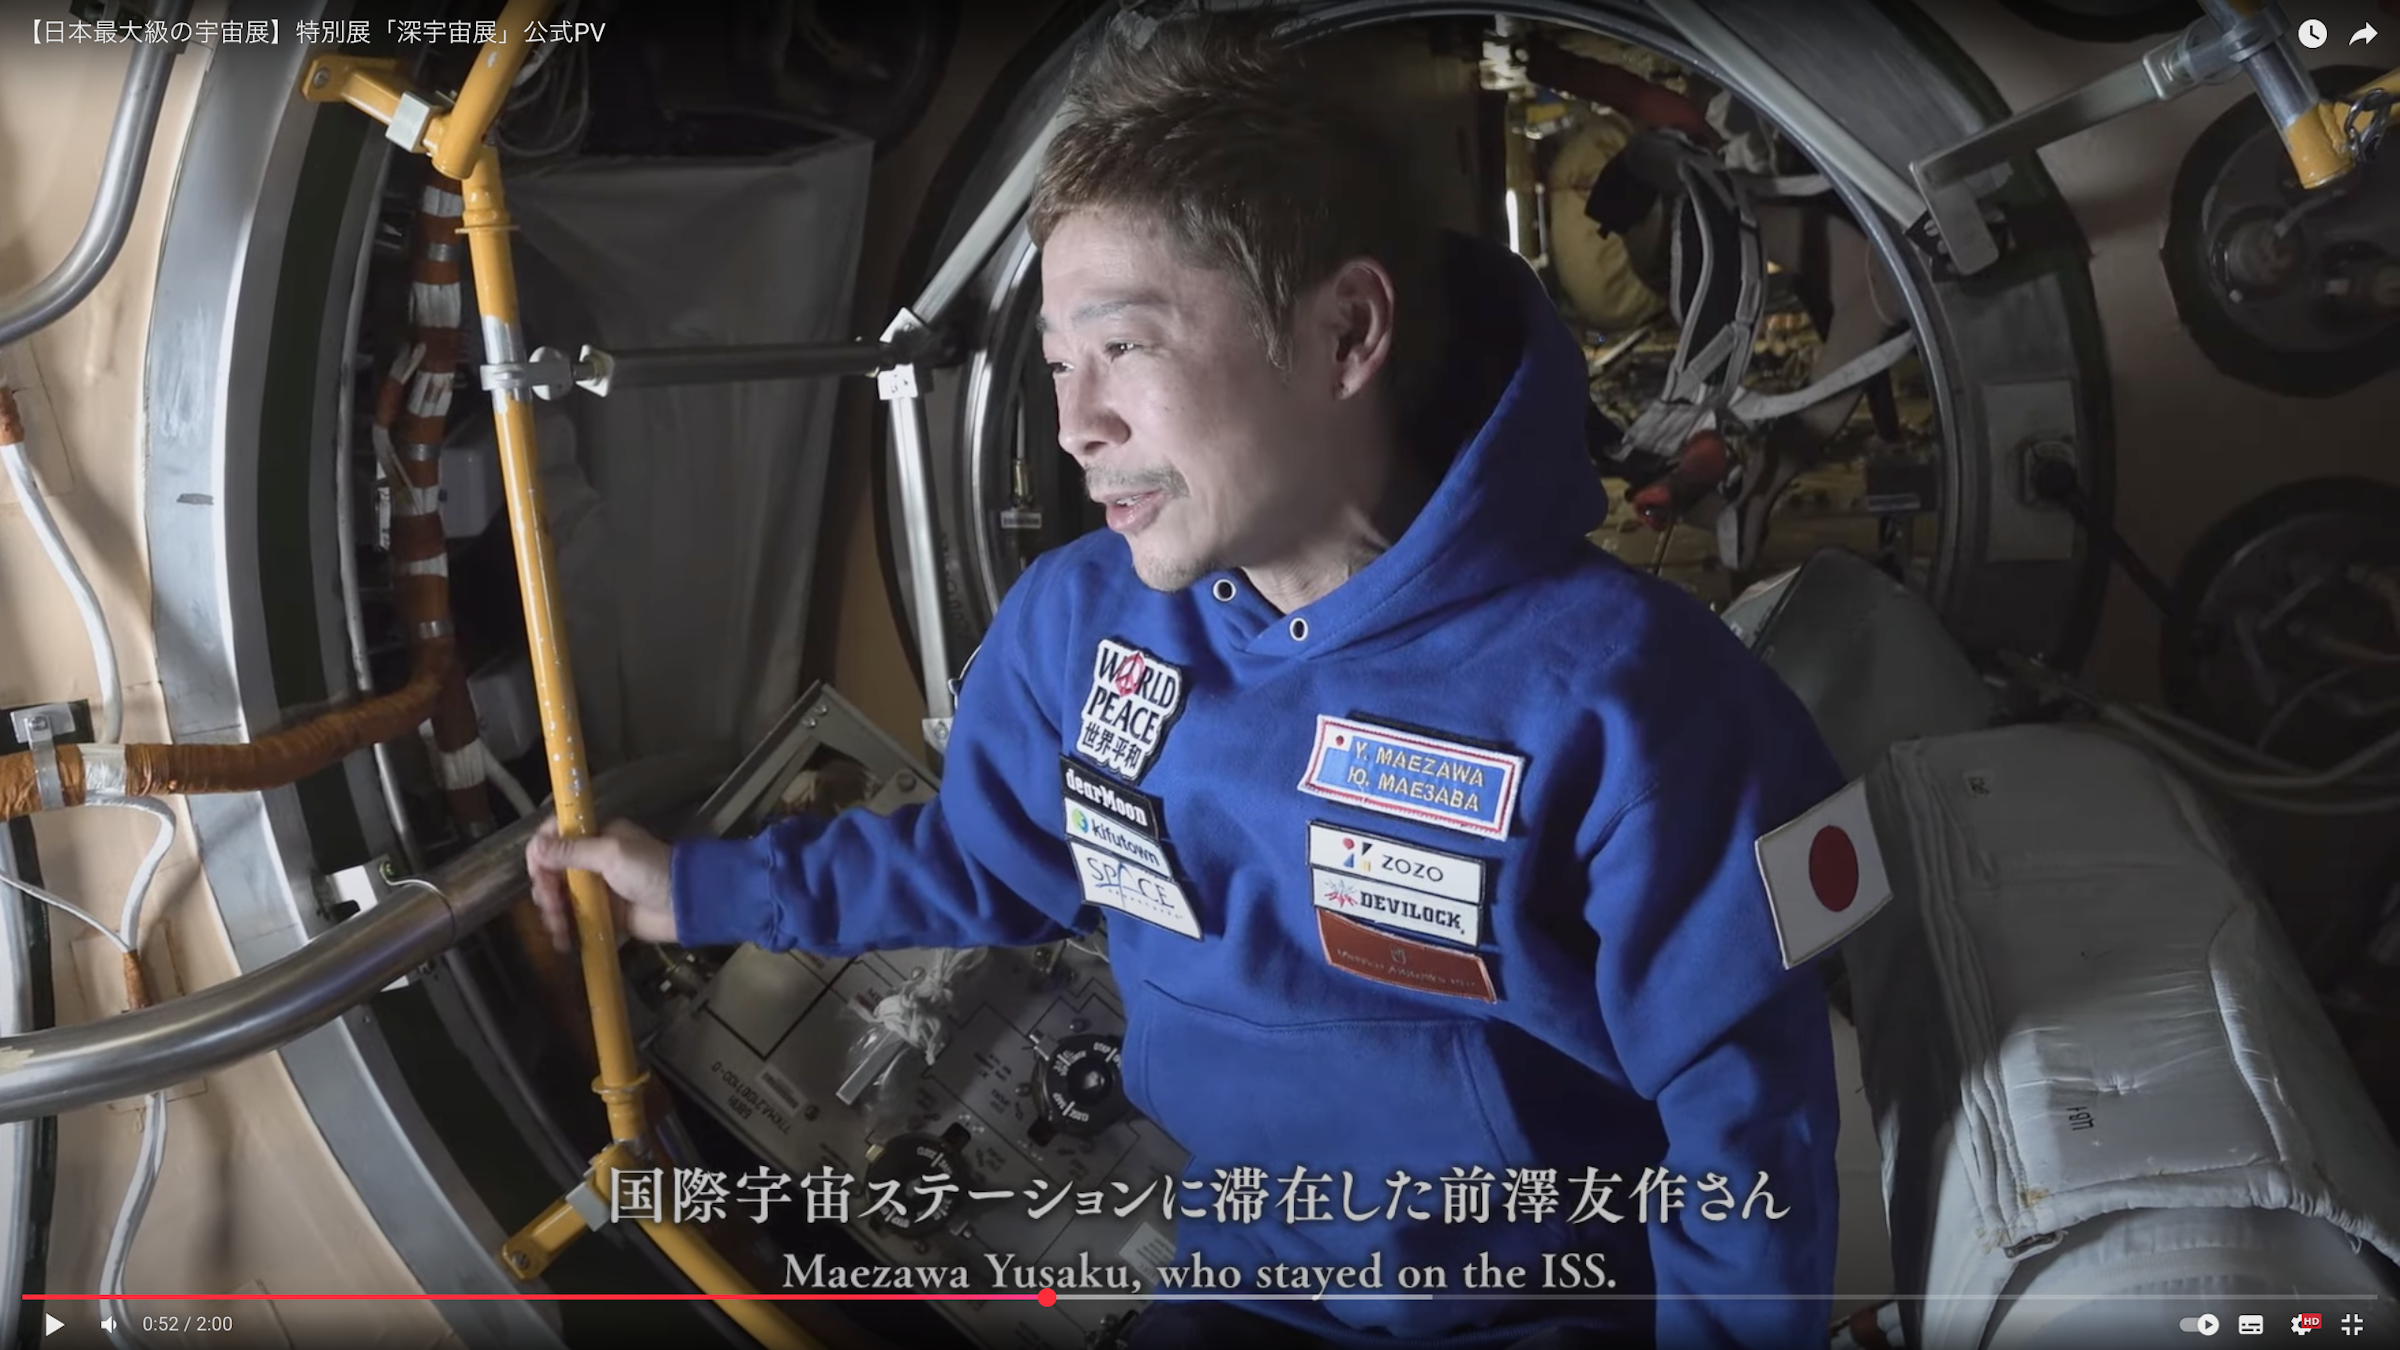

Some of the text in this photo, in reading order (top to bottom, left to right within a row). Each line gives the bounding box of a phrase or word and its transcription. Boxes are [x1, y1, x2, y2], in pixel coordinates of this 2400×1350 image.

[1098, 647, 1178, 710] WORLD
[1088, 685, 1160, 745] PEACE
[1081, 721, 1142, 770] 世界平和
[1354, 740, 1485, 788] Y. MAEZAWA
[1377, 772, 1480, 812] МАЕЗАВА
[1091, 817, 1161, 869] kifutown
[1087, 856, 1175, 909] SPACE
[1381, 854, 1444, 883] ZOZO
